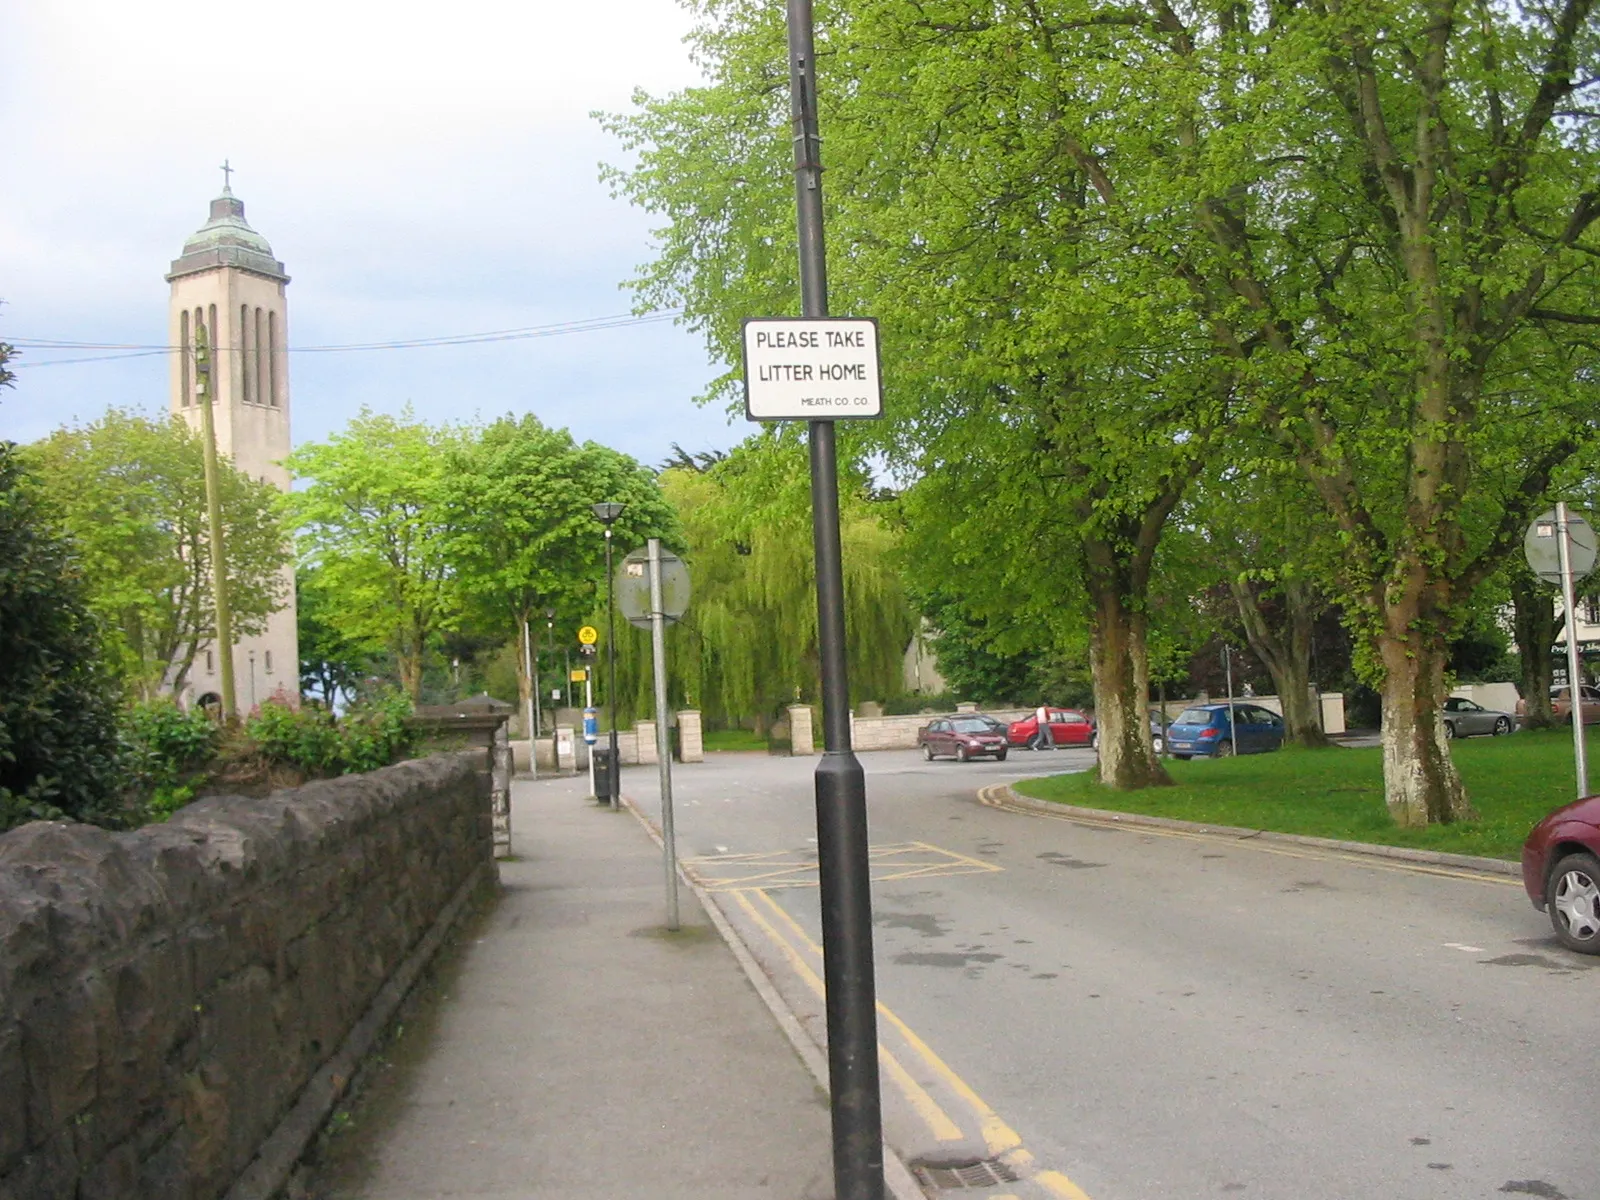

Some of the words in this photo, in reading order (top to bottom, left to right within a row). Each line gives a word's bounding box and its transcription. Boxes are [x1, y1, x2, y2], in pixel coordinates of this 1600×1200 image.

[757, 331, 819, 348] PLEASE
[825, 331, 865, 347] TAKE
[760, 365, 813, 381] LITTER
[820, 364, 866, 380] HOME
[801, 397, 832, 406] MEATH
